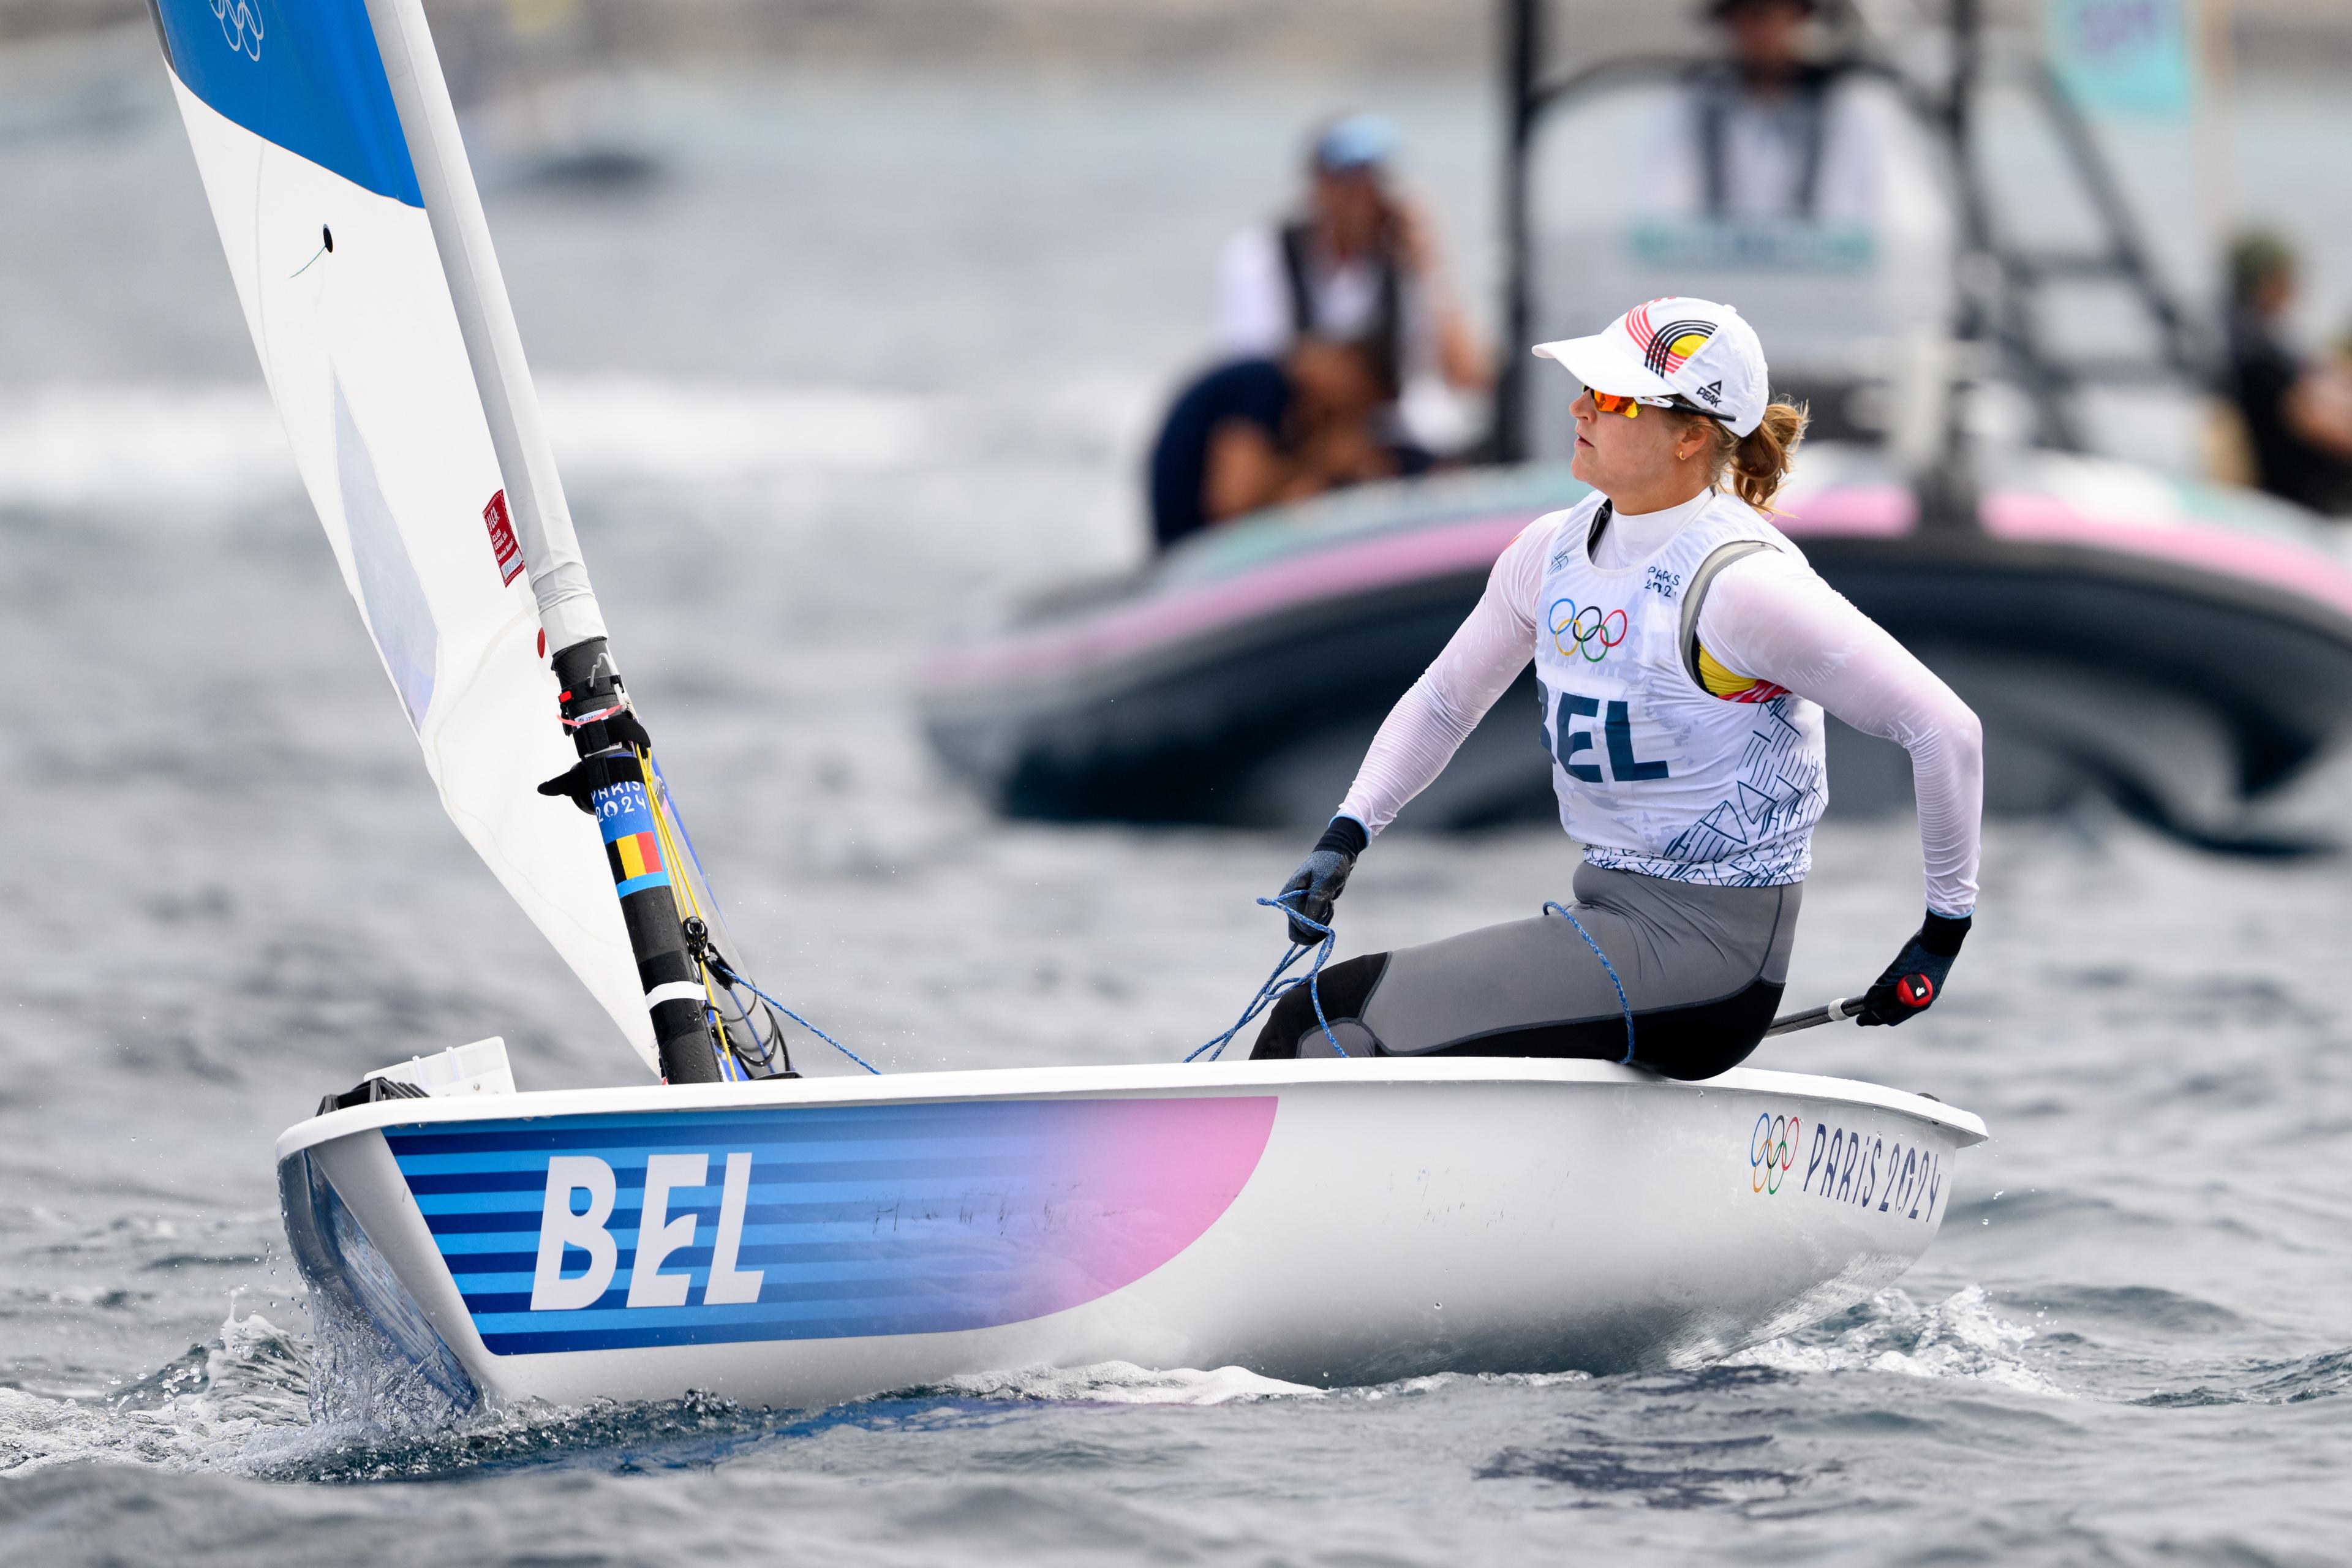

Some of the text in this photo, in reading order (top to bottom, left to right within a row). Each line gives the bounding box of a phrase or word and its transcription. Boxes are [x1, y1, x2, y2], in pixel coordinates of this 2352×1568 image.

[1696, 386, 1722, 408] PEAK
[1644, 579, 1676, 597] 202
[595, 794, 646, 823] 2024
[1803, 1123, 1940, 1222] PARIS 2024
[530, 1152, 764, 1311] BEL
